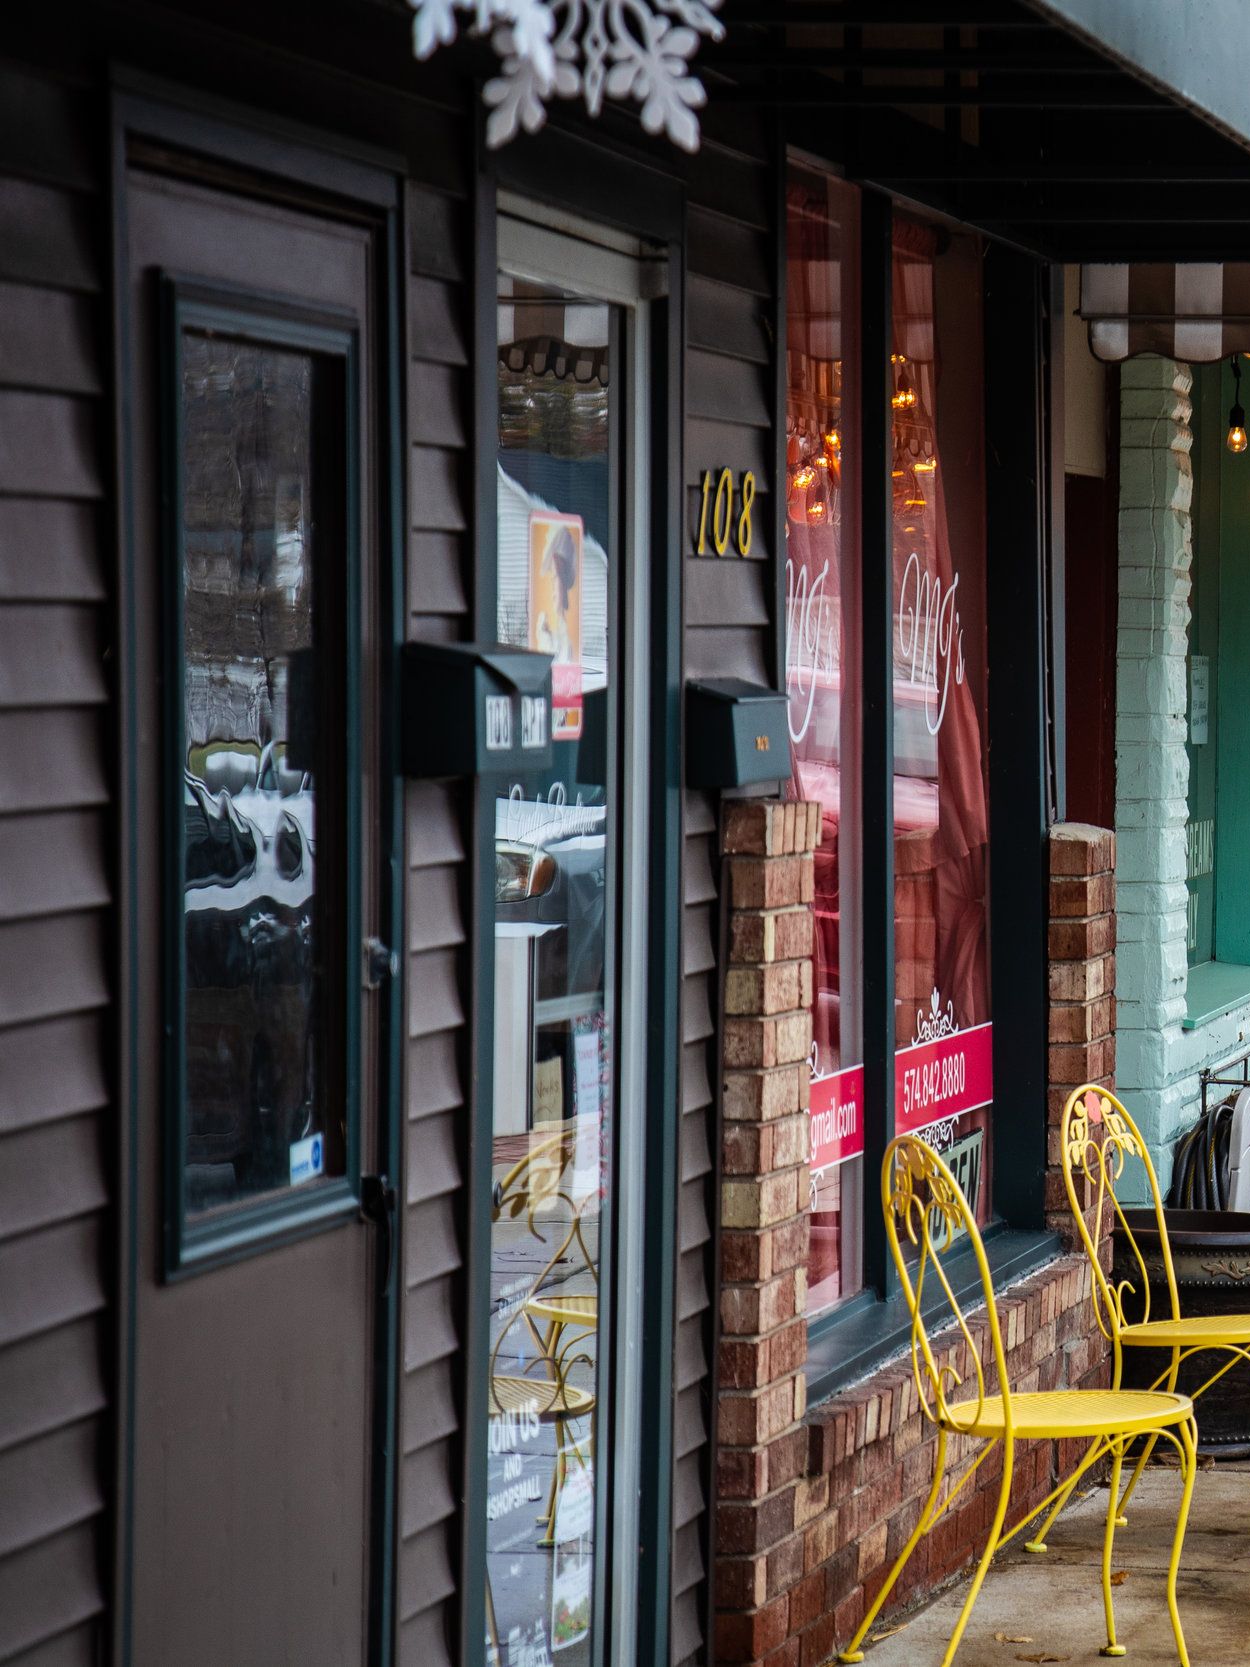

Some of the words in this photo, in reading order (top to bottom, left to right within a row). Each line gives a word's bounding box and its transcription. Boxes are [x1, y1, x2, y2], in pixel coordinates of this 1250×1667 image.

[698, 467, 755, 557] 108
[488, 700, 510, 745] 108
[903, 1051, 966, 1115] 574.842.8880
[519, 1397, 541, 1442] US
[503, 1453, 522, 1482] AND
